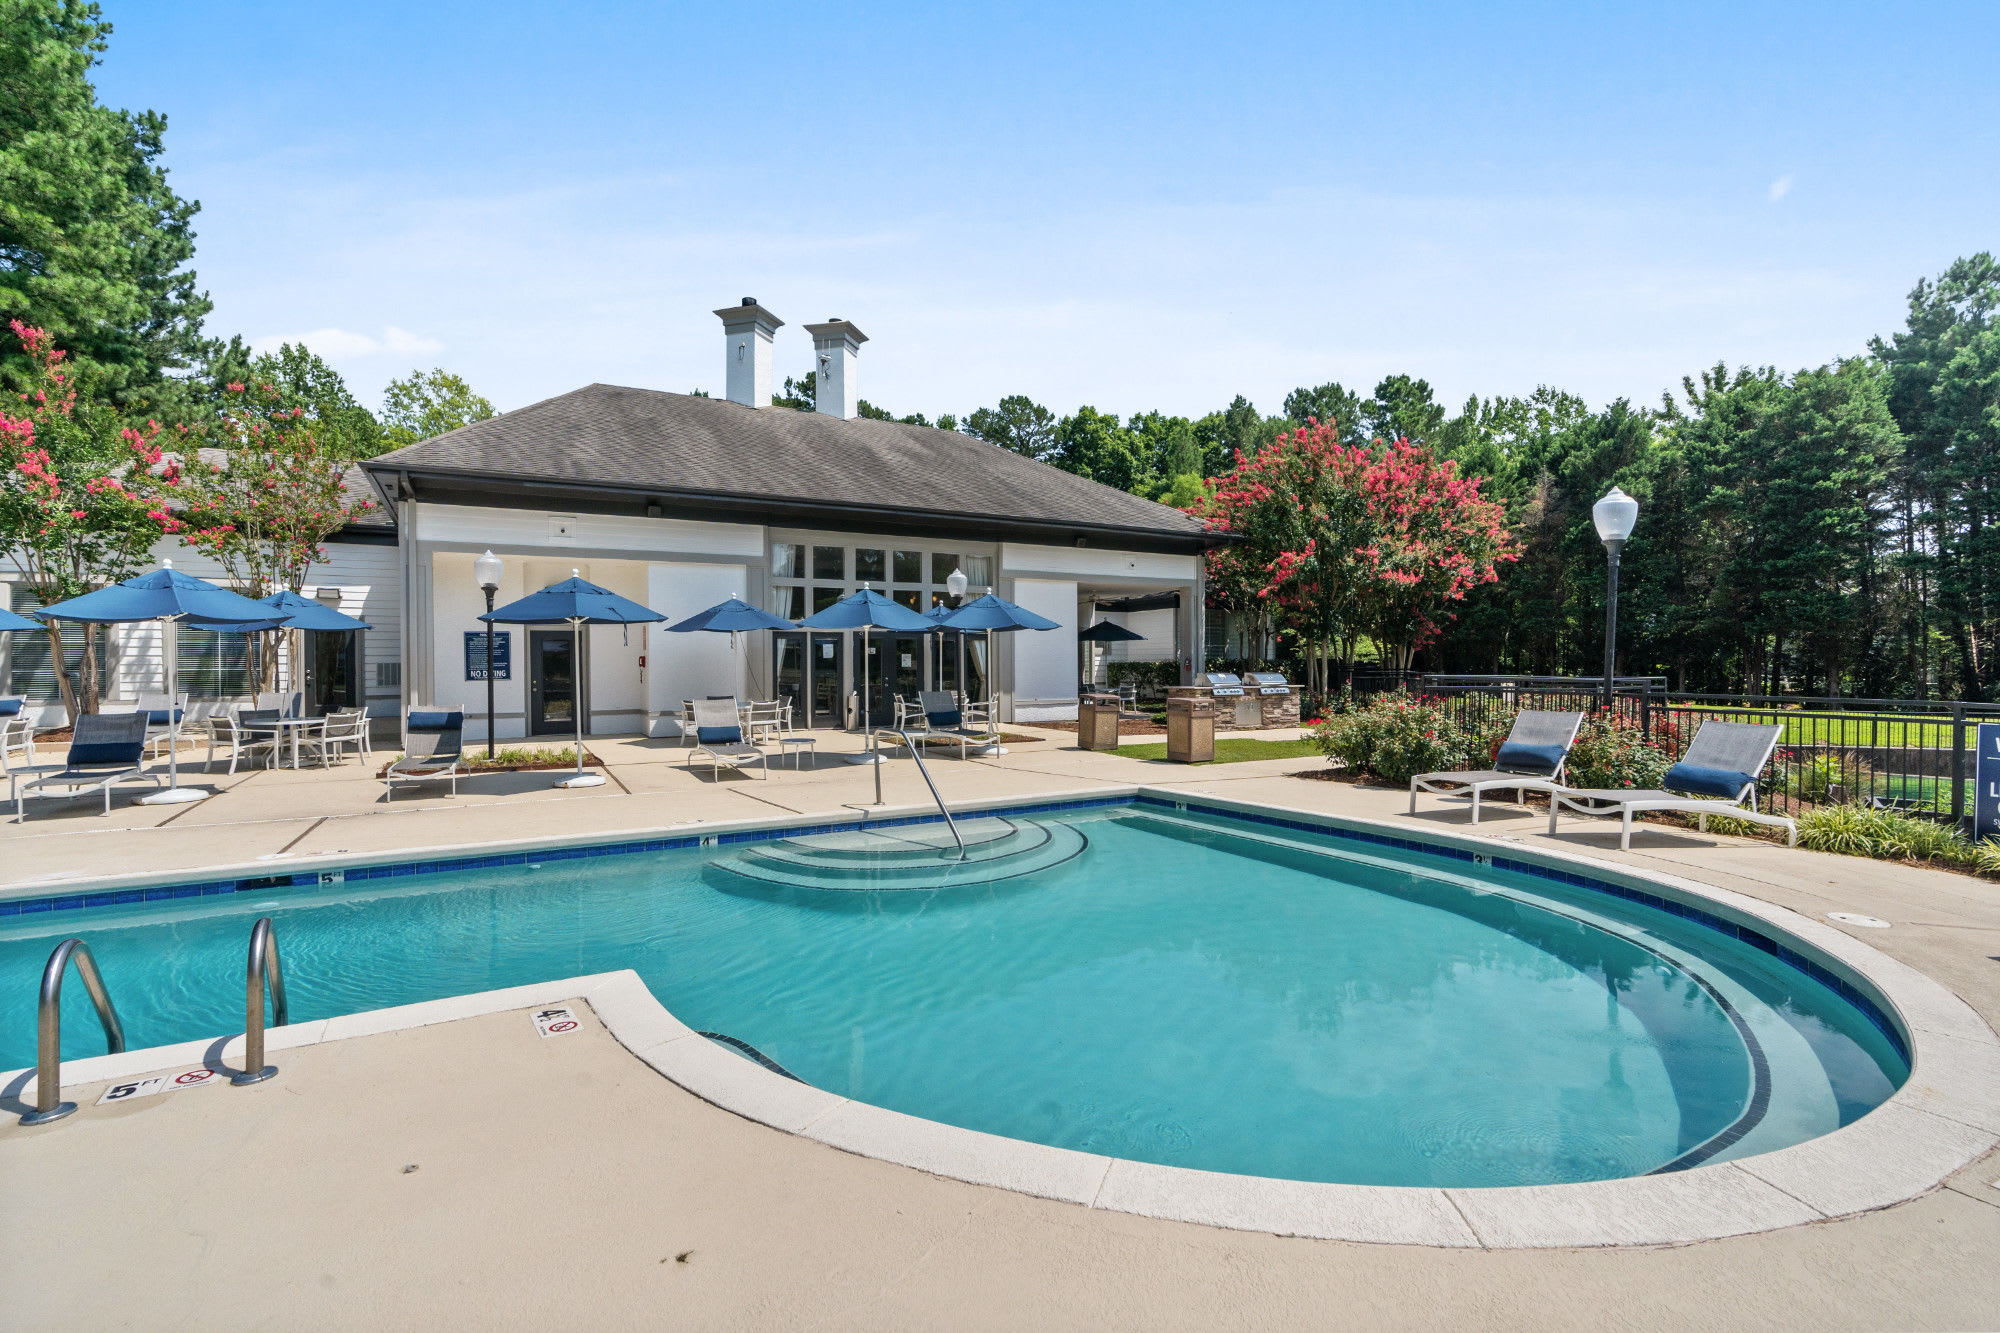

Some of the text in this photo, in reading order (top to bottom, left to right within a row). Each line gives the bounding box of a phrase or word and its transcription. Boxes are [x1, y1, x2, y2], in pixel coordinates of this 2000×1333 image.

[470, 670, 481, 678] NO
[321, 872, 333, 883] 5
[106, 1082, 139, 1100] 5
[141, 1077, 162, 1087] FT
